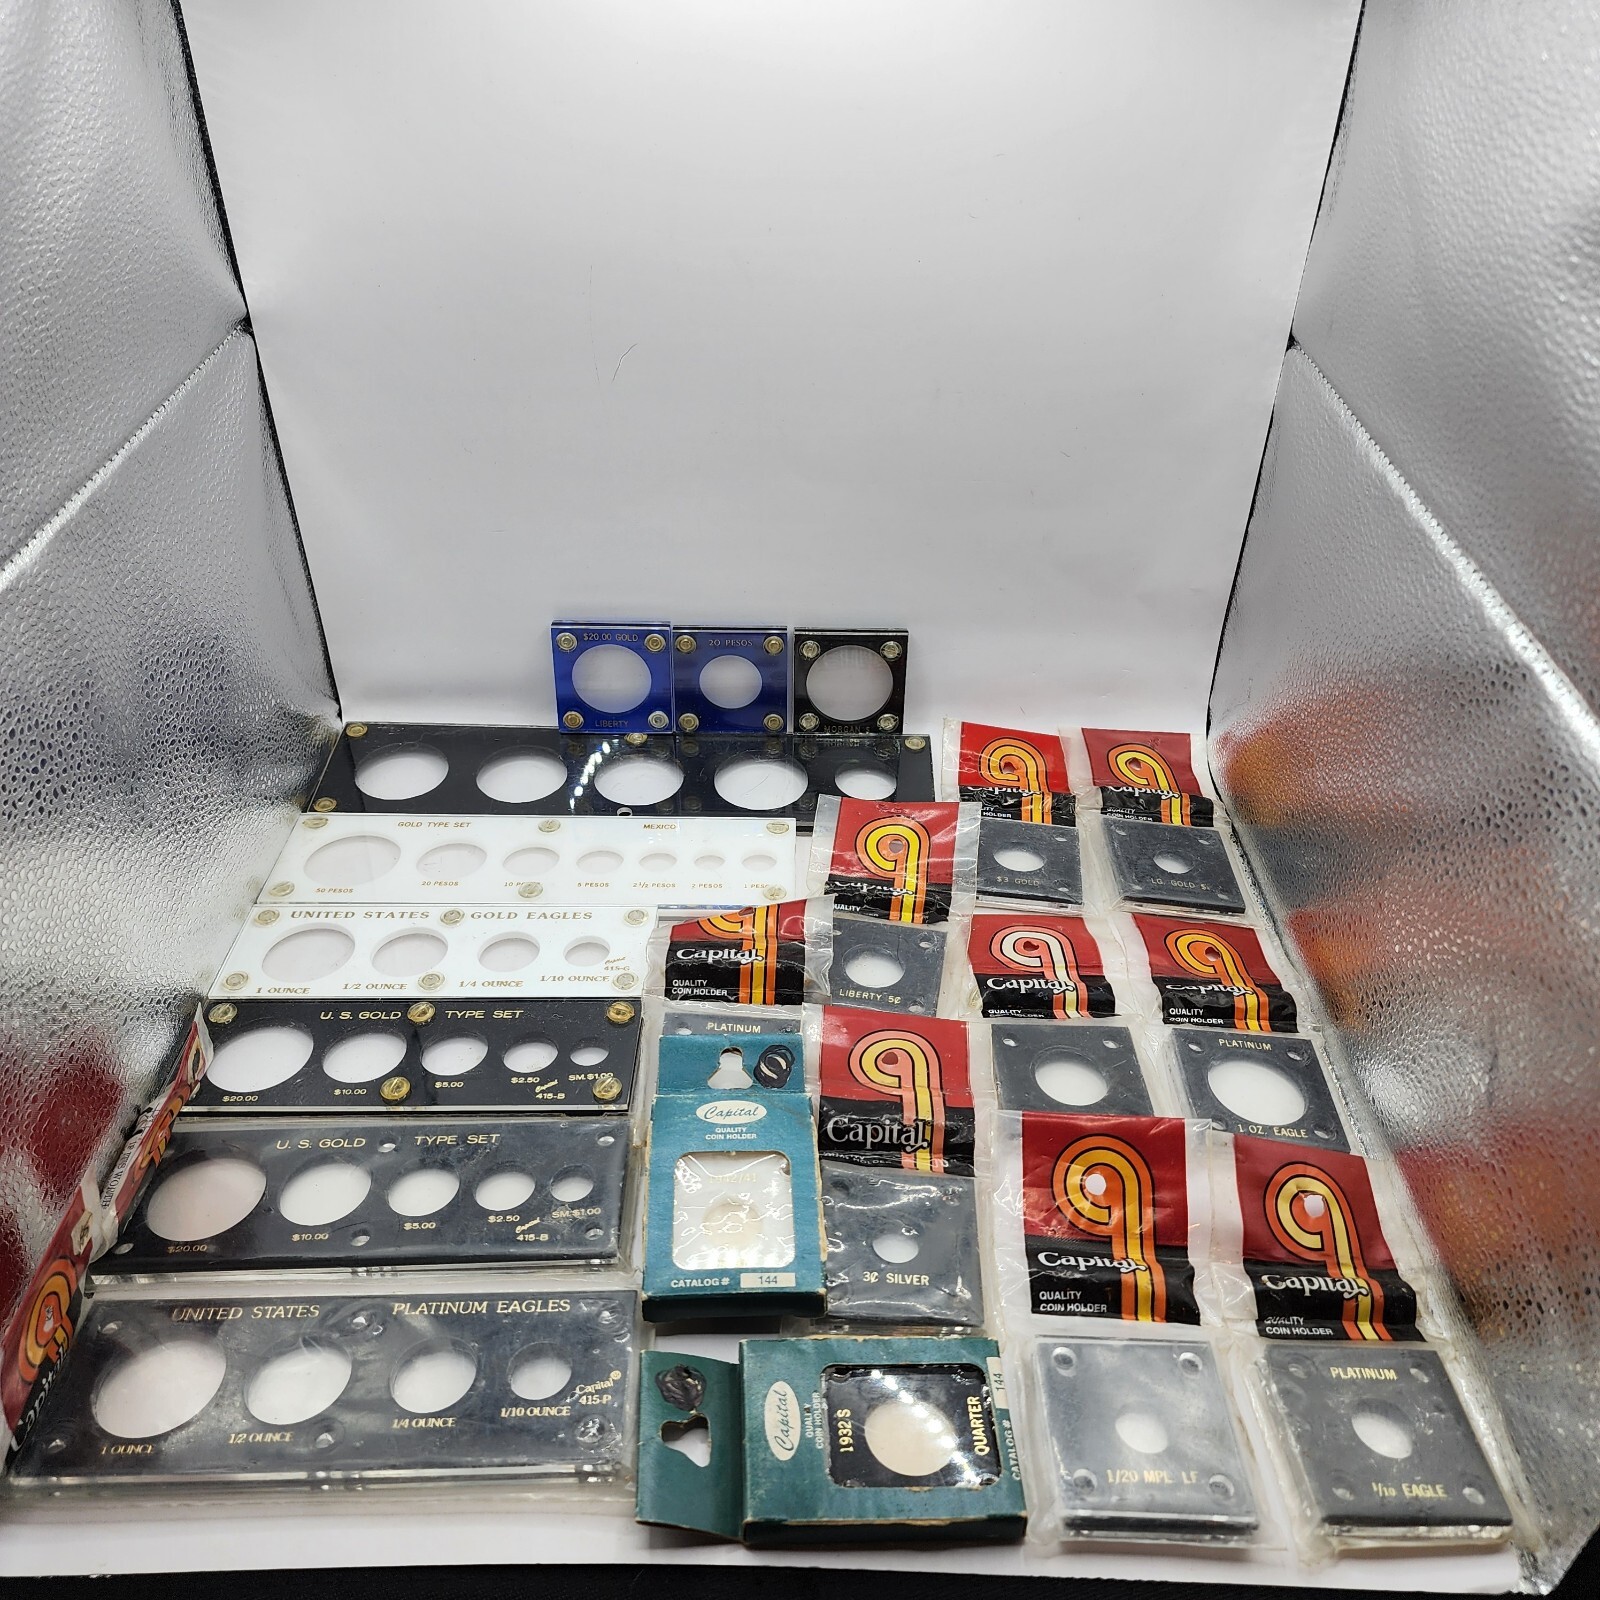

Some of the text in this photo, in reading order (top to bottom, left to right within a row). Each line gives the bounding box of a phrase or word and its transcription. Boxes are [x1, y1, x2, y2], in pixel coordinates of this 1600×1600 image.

[583, 632, 639, 642] $20.00 GOLD
[708, 639, 753, 647] 20 PESOS
[594, 720, 629, 728] LIBERTY
[824, 725, 860, 733] MORGAN
[1014, 878, 1040, 887] GOLD
[1171, 879, 1195, 889] GOLD
[291, 911, 430, 919] UNITED STATES
[471, 912, 593, 920] GOLD EAGLES
[676, 948, 764, 965] Capital
[672, 979, 708, 987] QUALITY
[986, 978, 1075, 994] Capital
[672, 987, 727, 996] COIN HOLDER
[839, 988, 882, 1001] LIBERTY
[1166, 984, 1254, 996] Capital
[320, 1011, 402, 1020] U. S. GOLD
[445, 1010, 524, 1019] TYPE SET
[1169, 1008, 1204, 1016] QUALITY
[707, 1022, 761, 1034] PLATINUM
[1219, 1038, 1273, 1051] PLATINUM
[334, 1088, 367, 1096] $10.00
[704, 1106, 759, 1120] Capital
[827, 1117, 928, 1152] Capital
[1239, 1124, 1309, 1139] 1 OZ. EAGLE
[276, 1138, 366, 1150] U. S. GOLD
[414, 1134, 501, 1145] TYPE SET
[101, 1170, 123, 1209] WORTH
[488, 1215, 520, 1223] $2.50
[403, 1222, 436, 1230] $5.00
[291, 1233, 329, 1241] $10.00
[1037, 1251, 1148, 1273] Capital
[758, 1276, 777, 1285] 144
[886, 1273, 930, 1286] SILVER
[1261, 1274, 1370, 1299] Capital
[1039, 1290, 1082, 1300] QUALITY
[172, 1305, 320, 1321] UNITED STATES
[392, 1299, 571, 1315] PLATINUM EAGLES
[1039, 1303, 1107, 1313] COIN HOLDER
[1264, 1316, 1304, 1326] QUALITY
[1266, 1326, 1334, 1336] COIN HOLDER
[1329, 1366, 1399, 1381] PLATINUM
[994, 1372, 1006, 1391] 144
[500, 1406, 571, 1418] 1/10 OUNCE
[392, 1417, 456, 1428] 1/4 OUNCE
[775, 1390, 795, 1452] Capital
[803, 1403, 814, 1438] QUALIY
[967, 1396, 990, 1457] QUARTER
[228, 1432, 294, 1444] 1/2 OUNCE
[814, 1428, 824, 1449] COIN
[101, 1445, 154, 1455] 1 OUNCE
[1106, 1468, 1199, 1485] 1/20 MPL LF
[1372, 1483, 1448, 1499] 1/10 EAGLE
